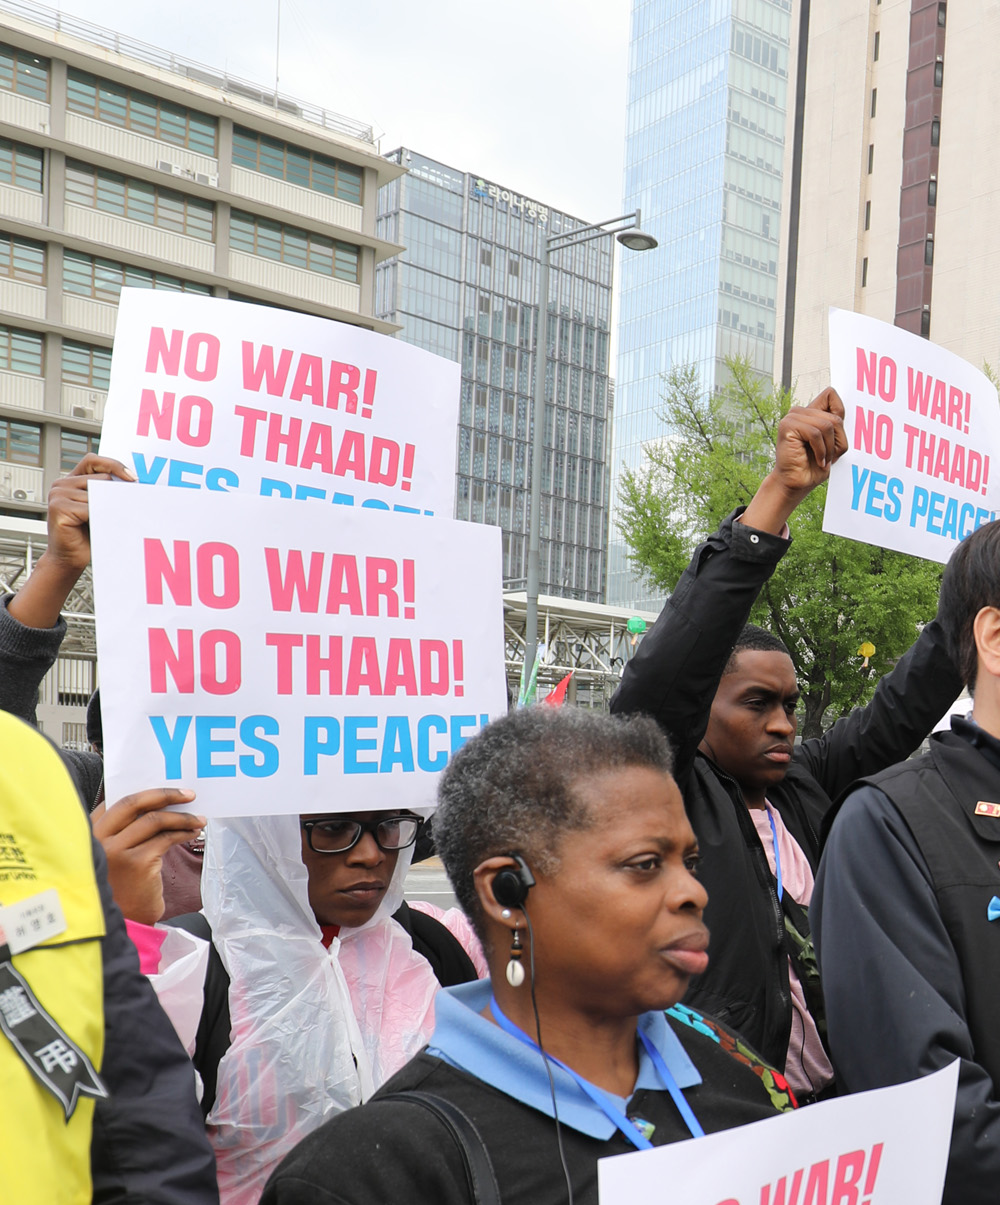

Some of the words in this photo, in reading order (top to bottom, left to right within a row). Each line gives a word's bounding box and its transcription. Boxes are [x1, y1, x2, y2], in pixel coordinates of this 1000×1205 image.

[489, 185, 549, 223] 라이나생명
[145, 326, 221, 382] NO
[241, 340, 377, 419] WAR!
[856, 347, 897, 403] NO
[907, 366, 971, 434] WAR!
[136, 388, 214, 448] NO
[234, 405, 416, 492] THAAD!
[854, 405, 894, 461] NO
[904, 423, 990, 496] THAAD!
[851, 464, 904, 522] YES
[909, 485, 996, 543] PEACE
[143, 538, 240, 610] NO
[264, 547, 415, 619] WAR!
[148, 627, 242, 696] NO
[265, 632, 464, 697] THAAD!
[148, 714, 280, 780] YES
[303, 714, 489, 776] PEACE
